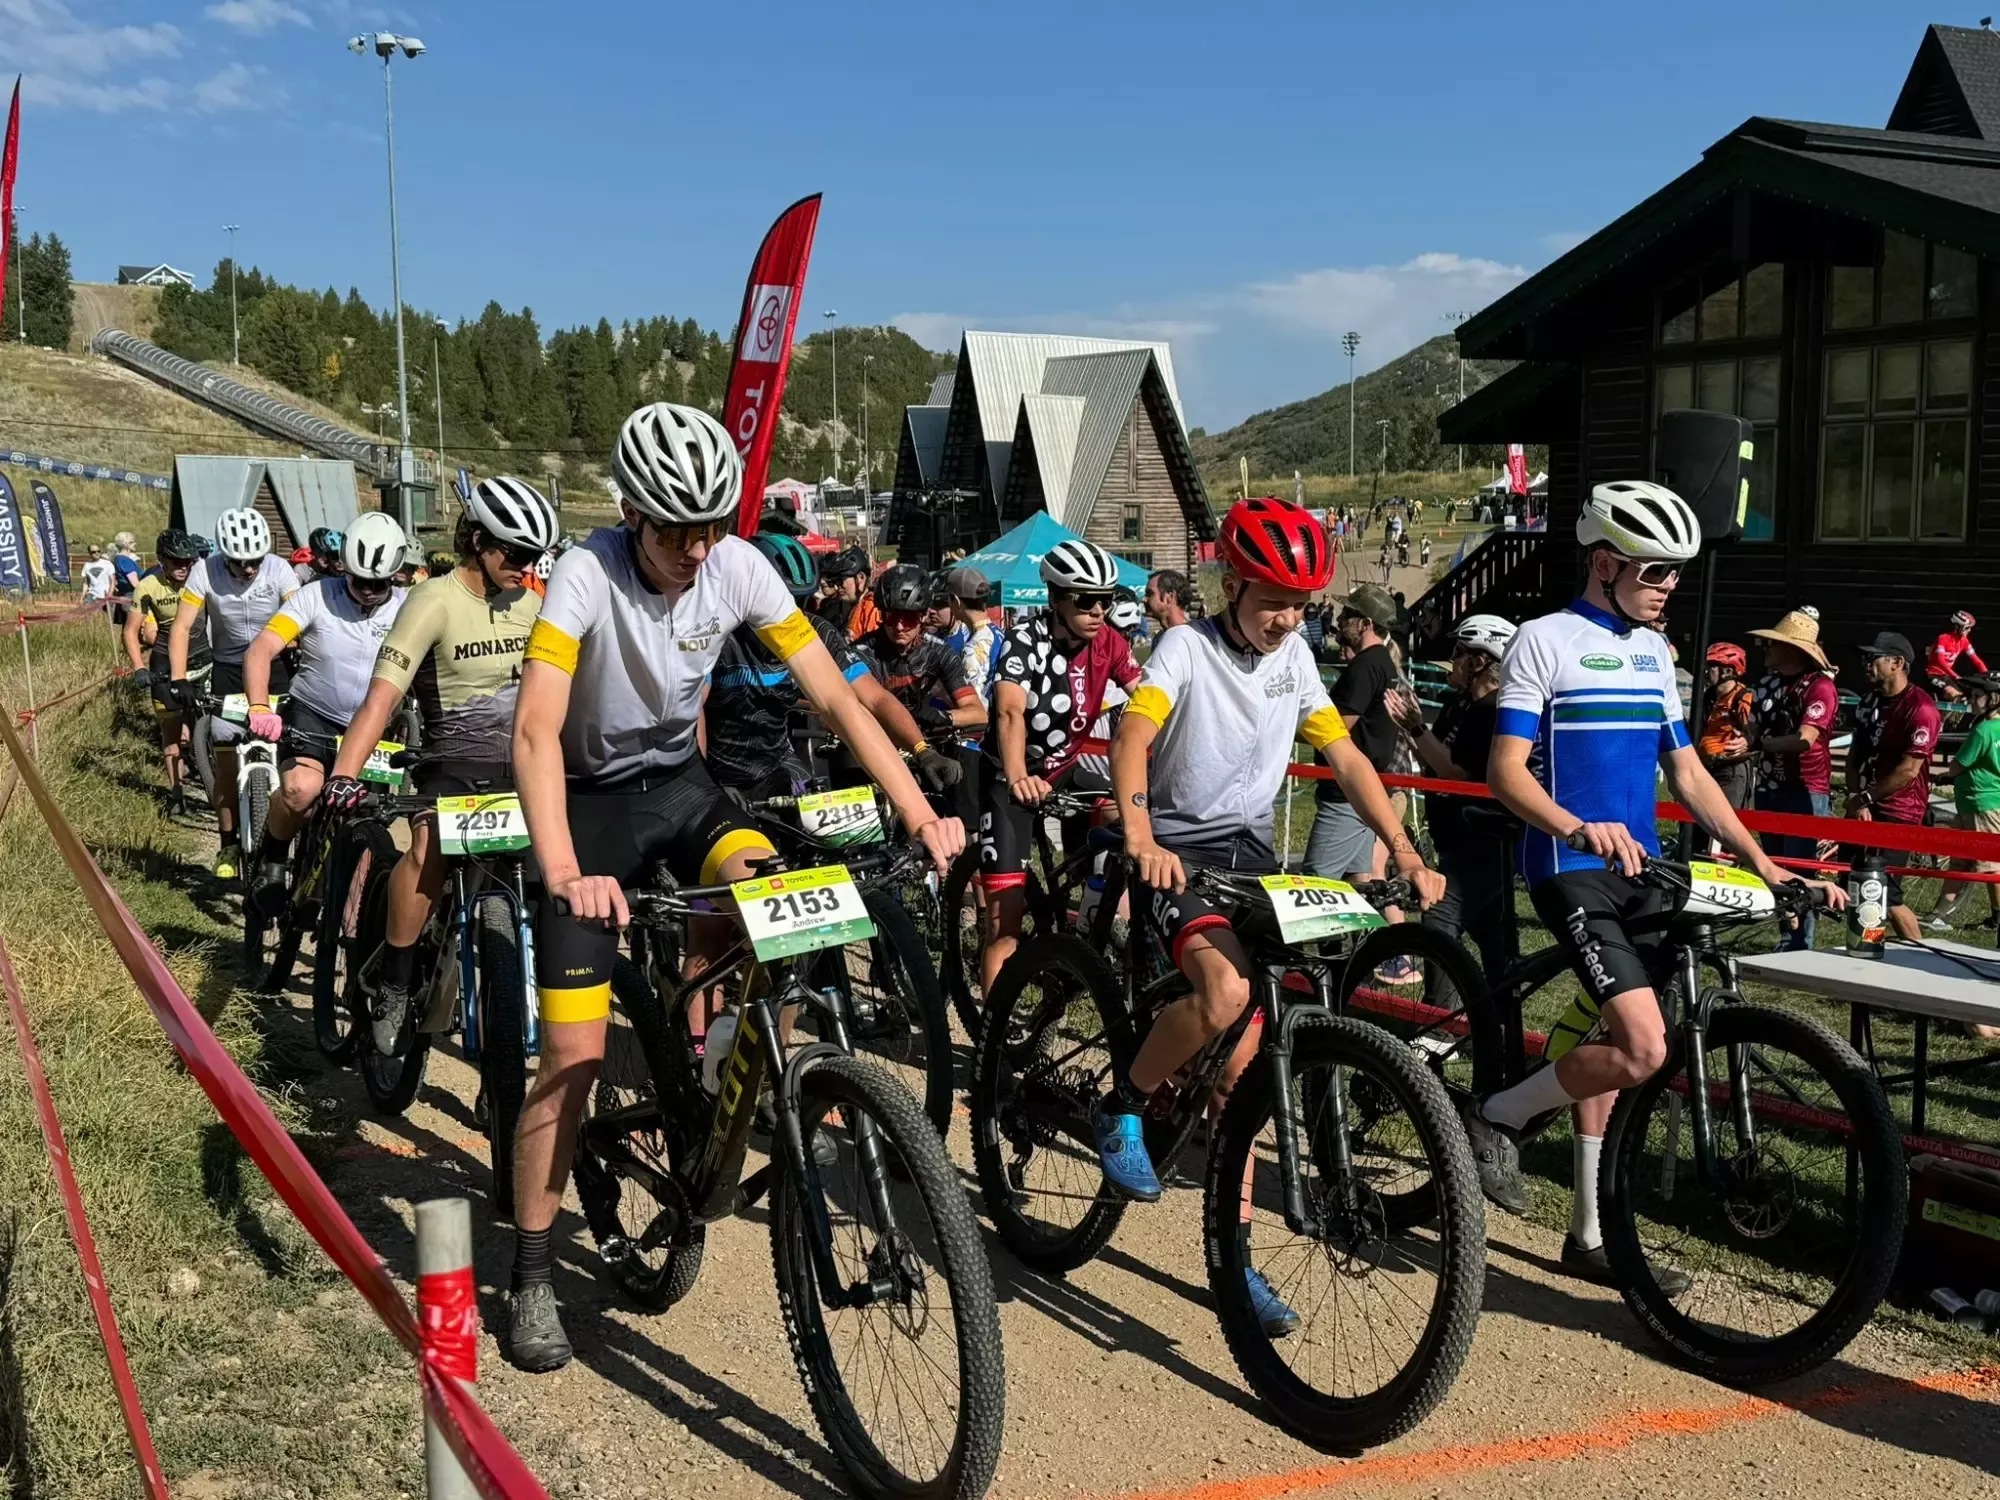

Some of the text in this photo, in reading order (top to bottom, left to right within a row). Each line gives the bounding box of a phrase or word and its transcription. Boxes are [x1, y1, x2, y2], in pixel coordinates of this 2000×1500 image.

[41, 499, 60, 566] JUNIOR VARSITY
[1585, 659, 1619, 667] COLORADO
[1630, 654, 1659, 667] LEADER
[1070, 664, 1088, 732] Creek
[455, 810, 511, 831] 2297
[815, 803, 867, 828] 2318
[980, 811, 998, 864] BJC
[784, 874, 816, 885] TOYOTA
[763, 886, 841, 924] 2153
[1288, 888, 1350, 909] 2057
[1706, 885, 1754, 909] 2553
[791, 916, 827, 929] Andrew
[1566, 906, 1589, 945] The
[565, 966, 595, 977] PRIMAL
[1902, 1135, 1944, 1154] OYOTA
